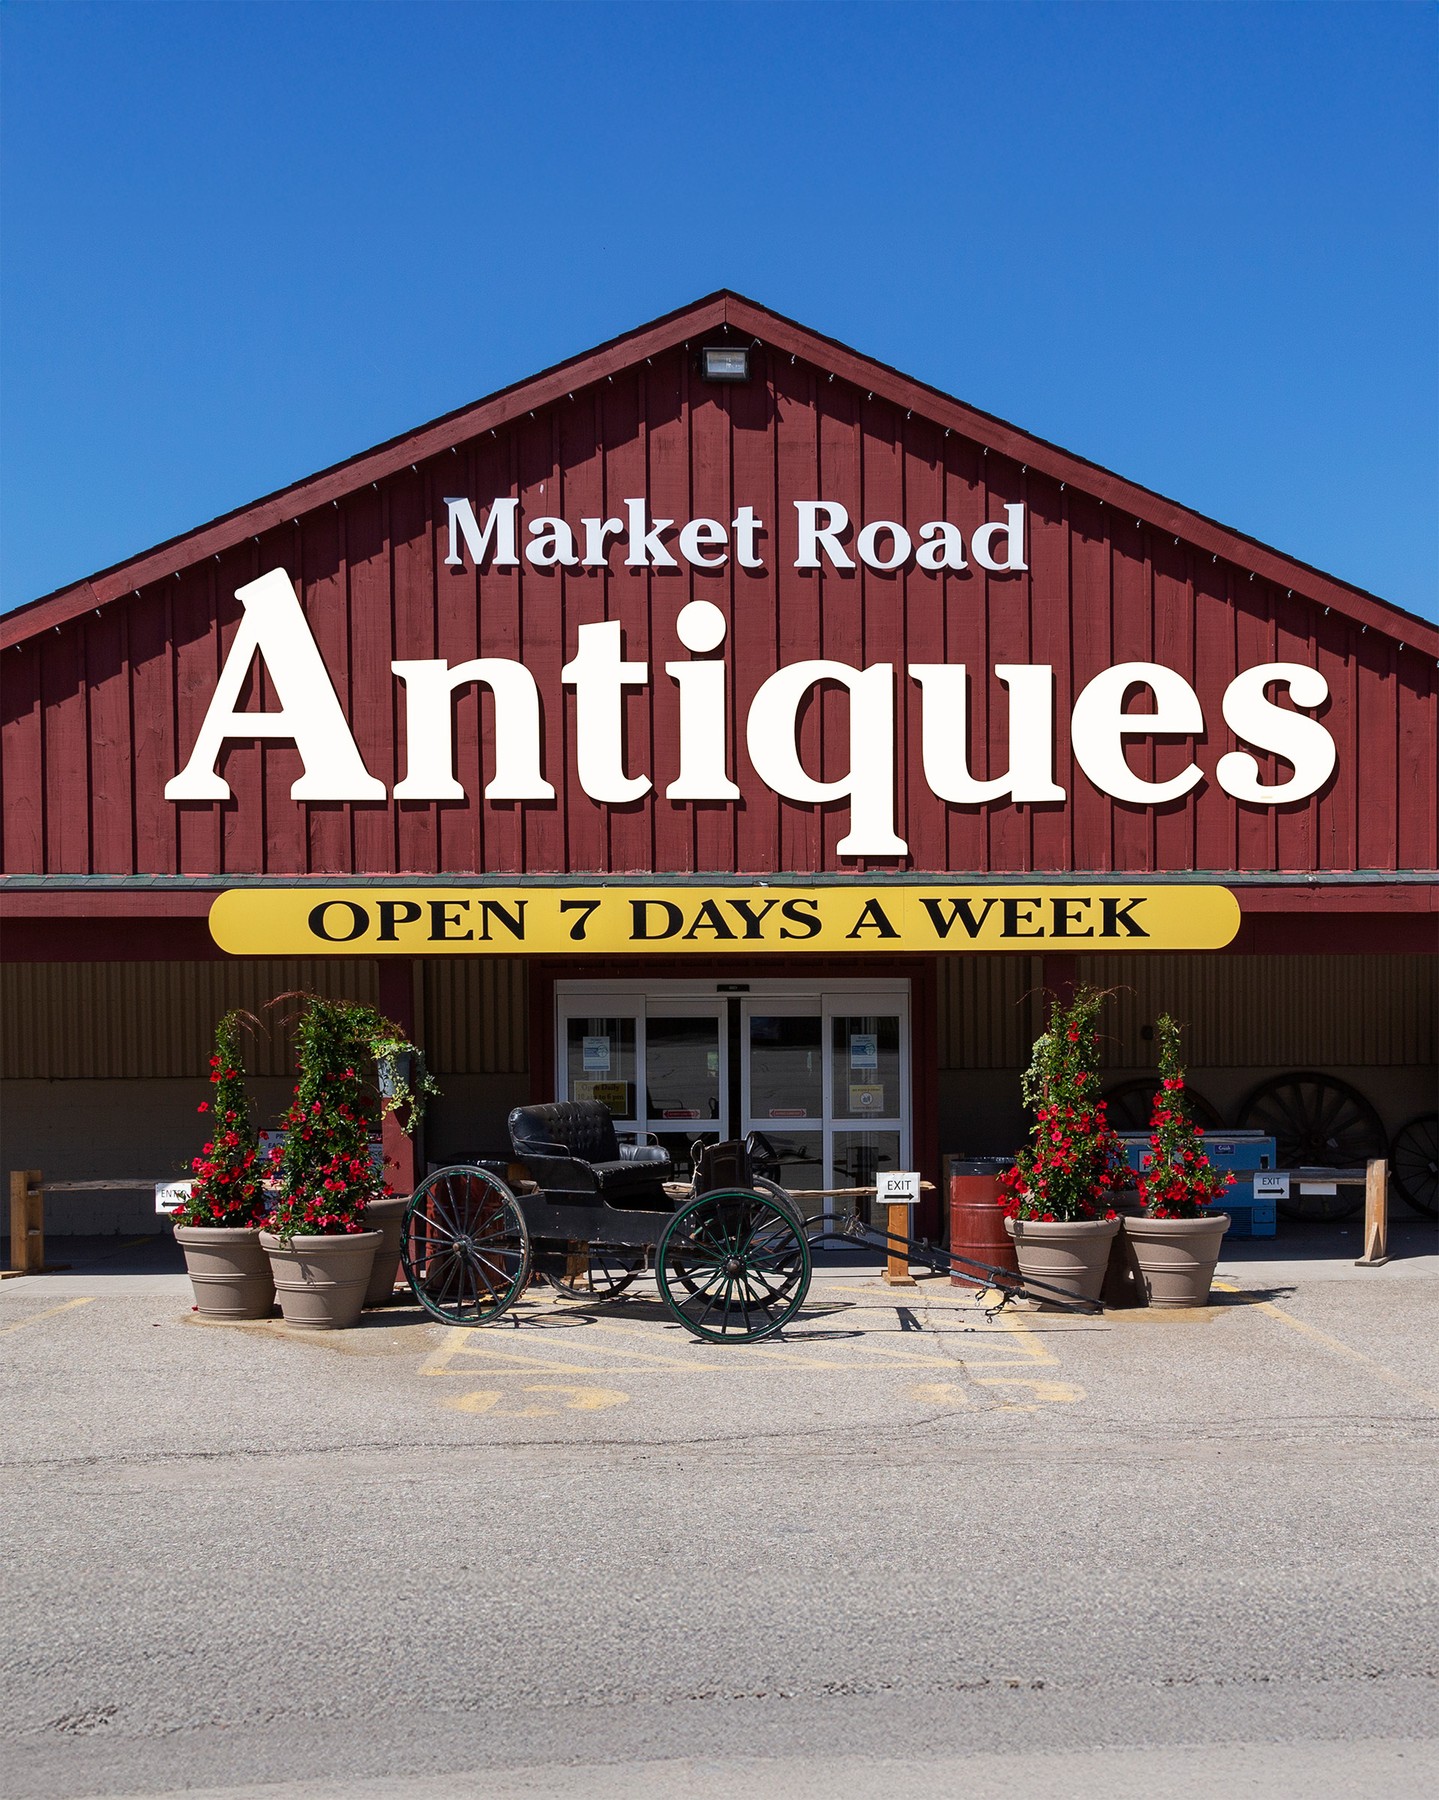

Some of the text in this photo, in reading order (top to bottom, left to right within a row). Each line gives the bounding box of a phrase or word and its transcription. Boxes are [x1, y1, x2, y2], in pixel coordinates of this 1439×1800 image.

[445, 497, 1028, 571] Market Road
[165, 567, 1335, 856] Antiques
[309, 898, 1150, 941] OPEN 7 DAYS A WEEK
[888, 1180, 912, 1191] EXIT
[1262, 1177, 1281, 1186] EXIT
